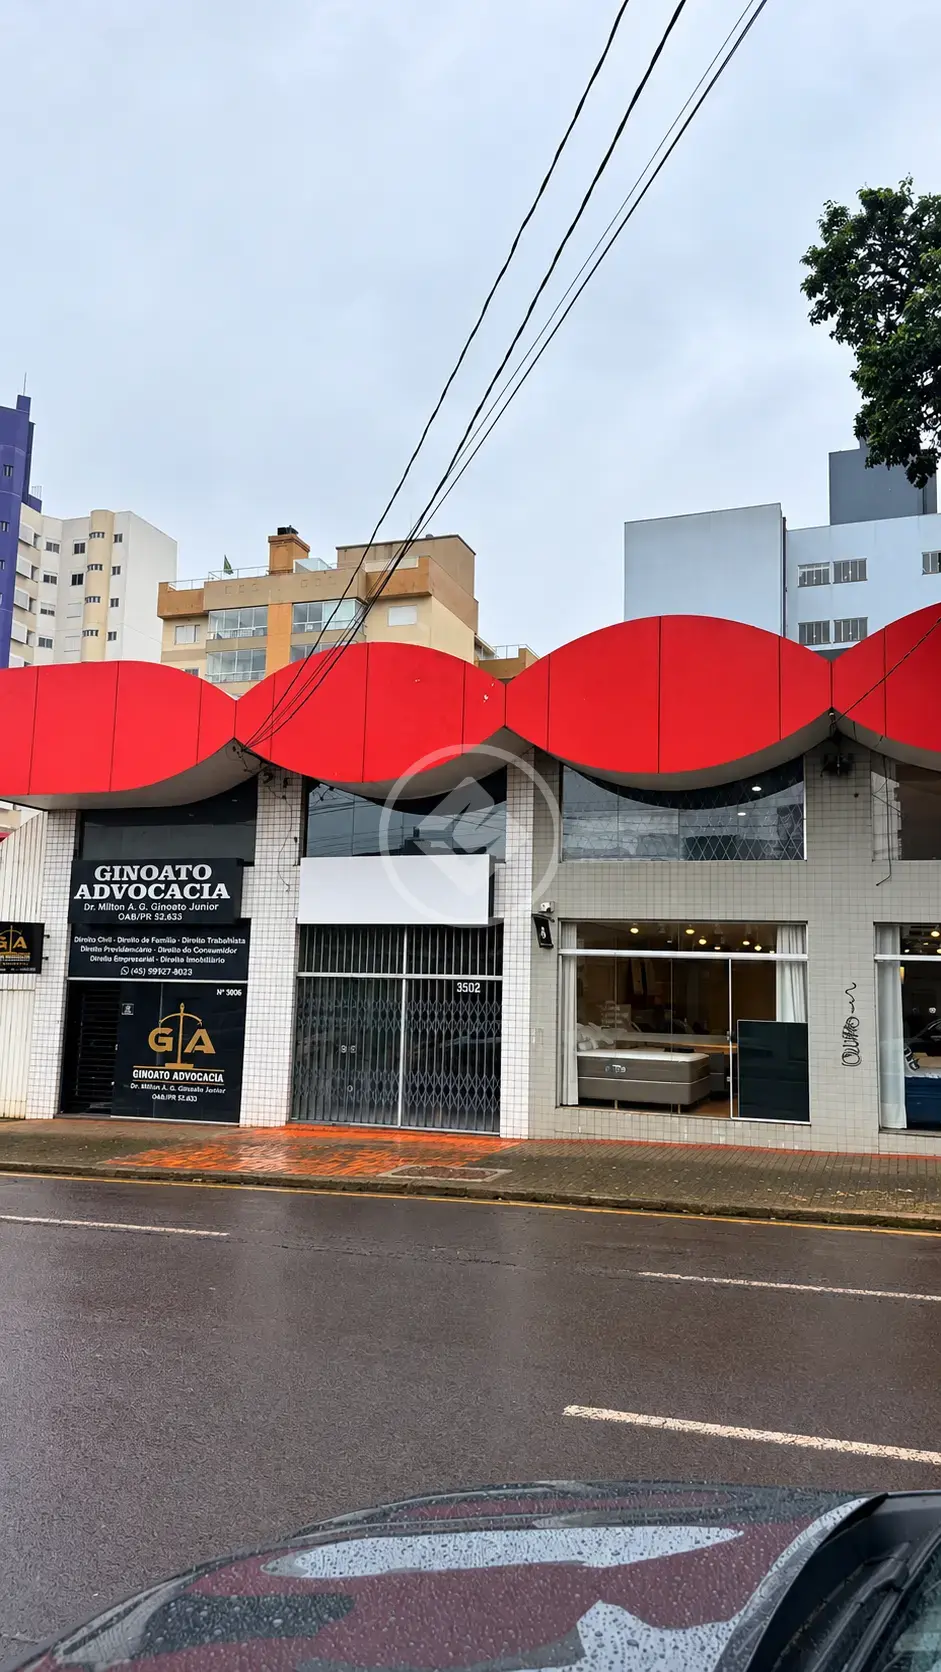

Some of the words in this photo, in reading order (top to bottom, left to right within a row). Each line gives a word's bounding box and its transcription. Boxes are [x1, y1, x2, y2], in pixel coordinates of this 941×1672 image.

[94, 864, 212, 881] GINOATO
[73, 883, 231, 900] ADVOCACIA
[84, 903, 96, 911] Dr.
[98, 903, 125, 911] Milton
[127, 903, 137, 911] A.
[139, 903, 148, 911] G.
[151, 902, 187, 911] Ginoato
[189, 902, 219, 911] Junior
[117, 912, 152, 921] OAB/PR
[456, 982, 481, 993] 3502
[132, 1069, 170, 1080] GINOATO
[172, 1071, 224, 1083] ADVOCACIA
